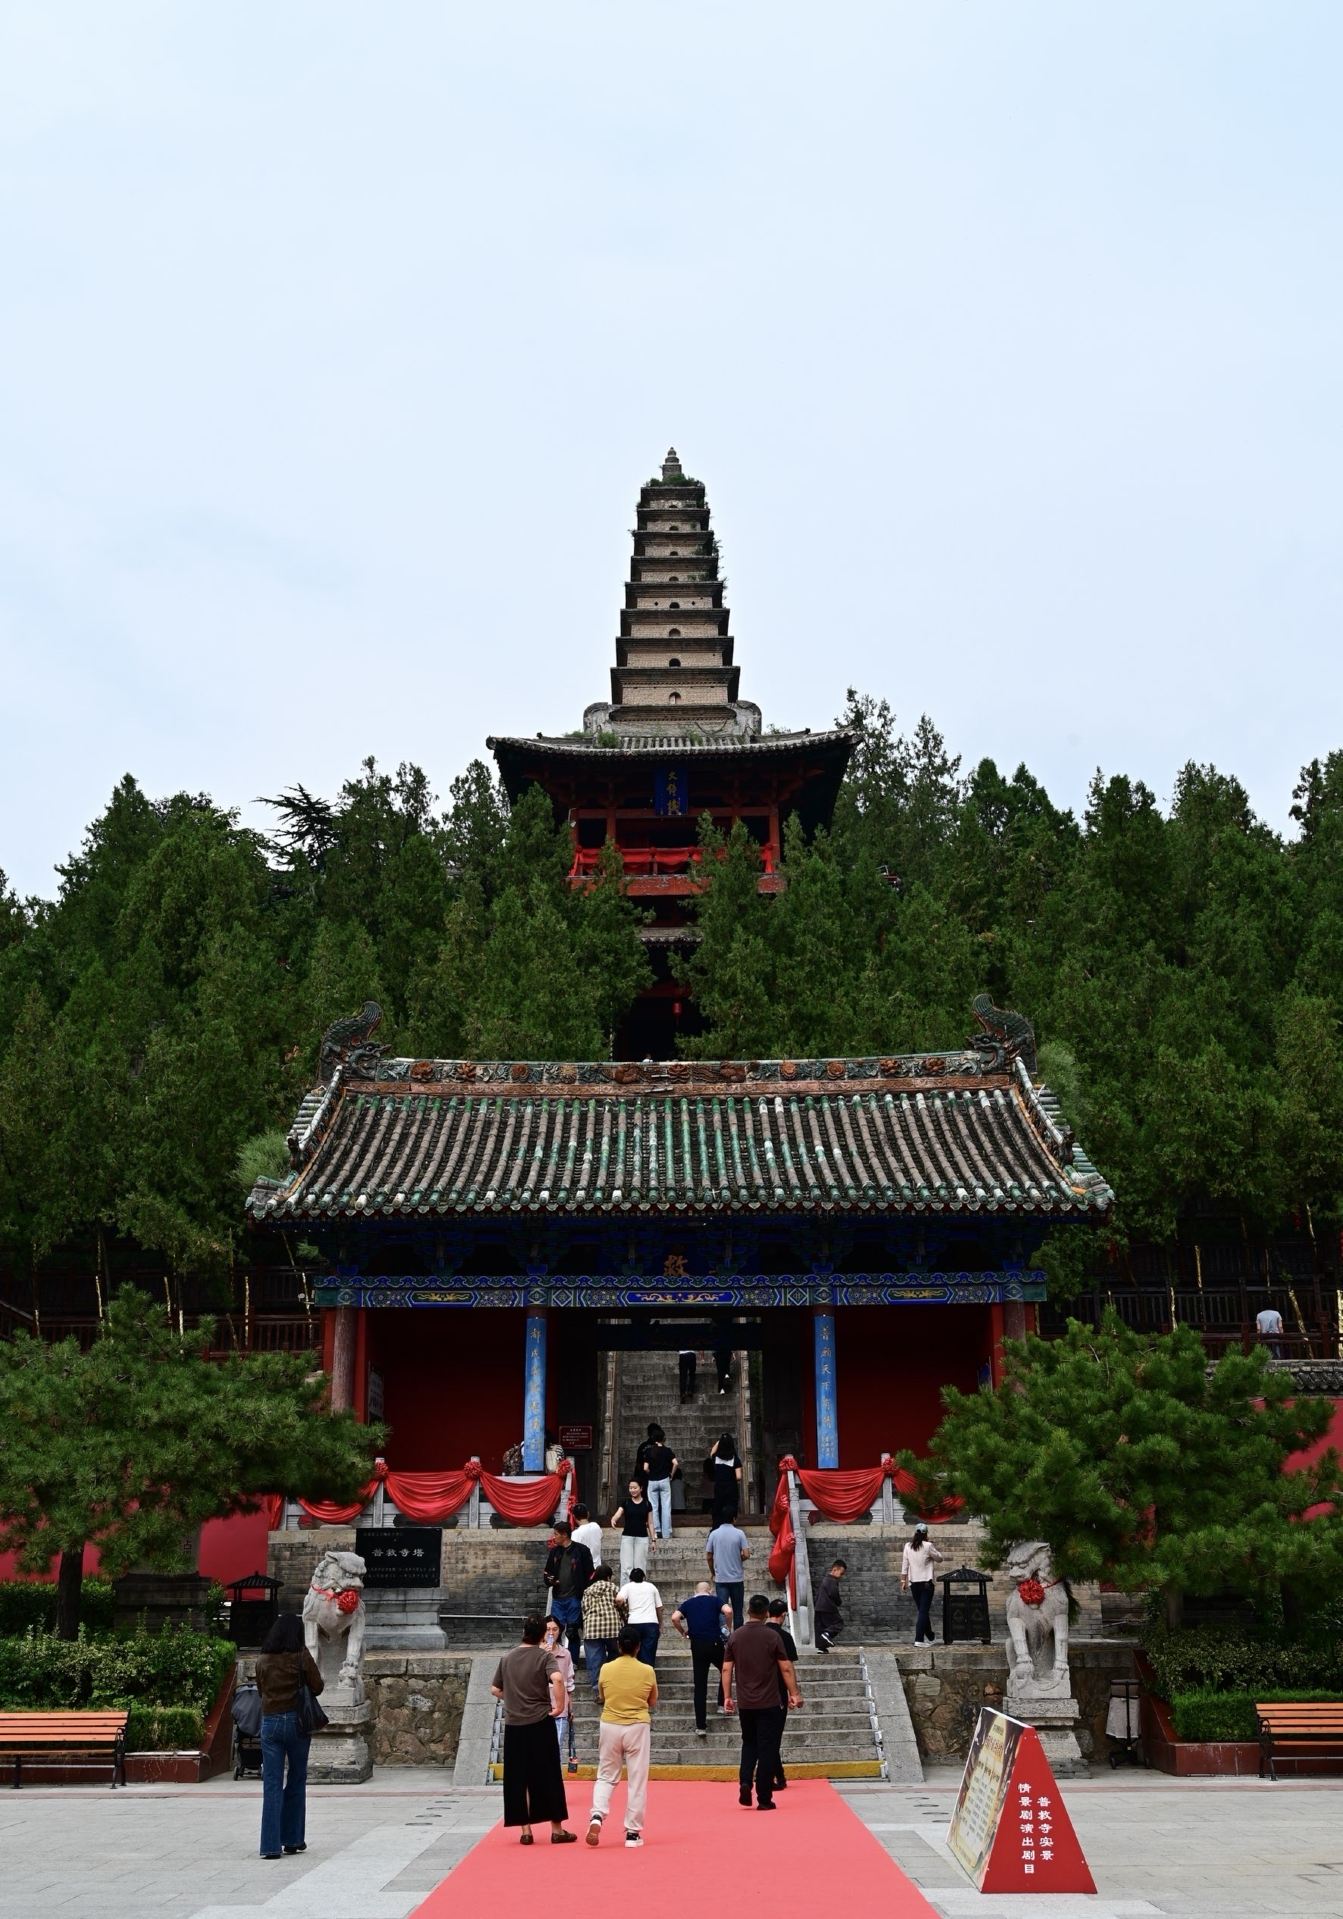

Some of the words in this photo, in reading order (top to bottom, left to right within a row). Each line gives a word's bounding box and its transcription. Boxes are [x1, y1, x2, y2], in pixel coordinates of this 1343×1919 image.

[371, 1547, 425, 1558] 普救寺塔
[1018, 1783, 1035, 1874] 情景剧演出剧目
[1037, 1796, 1054, 1861] 普救寺实景
